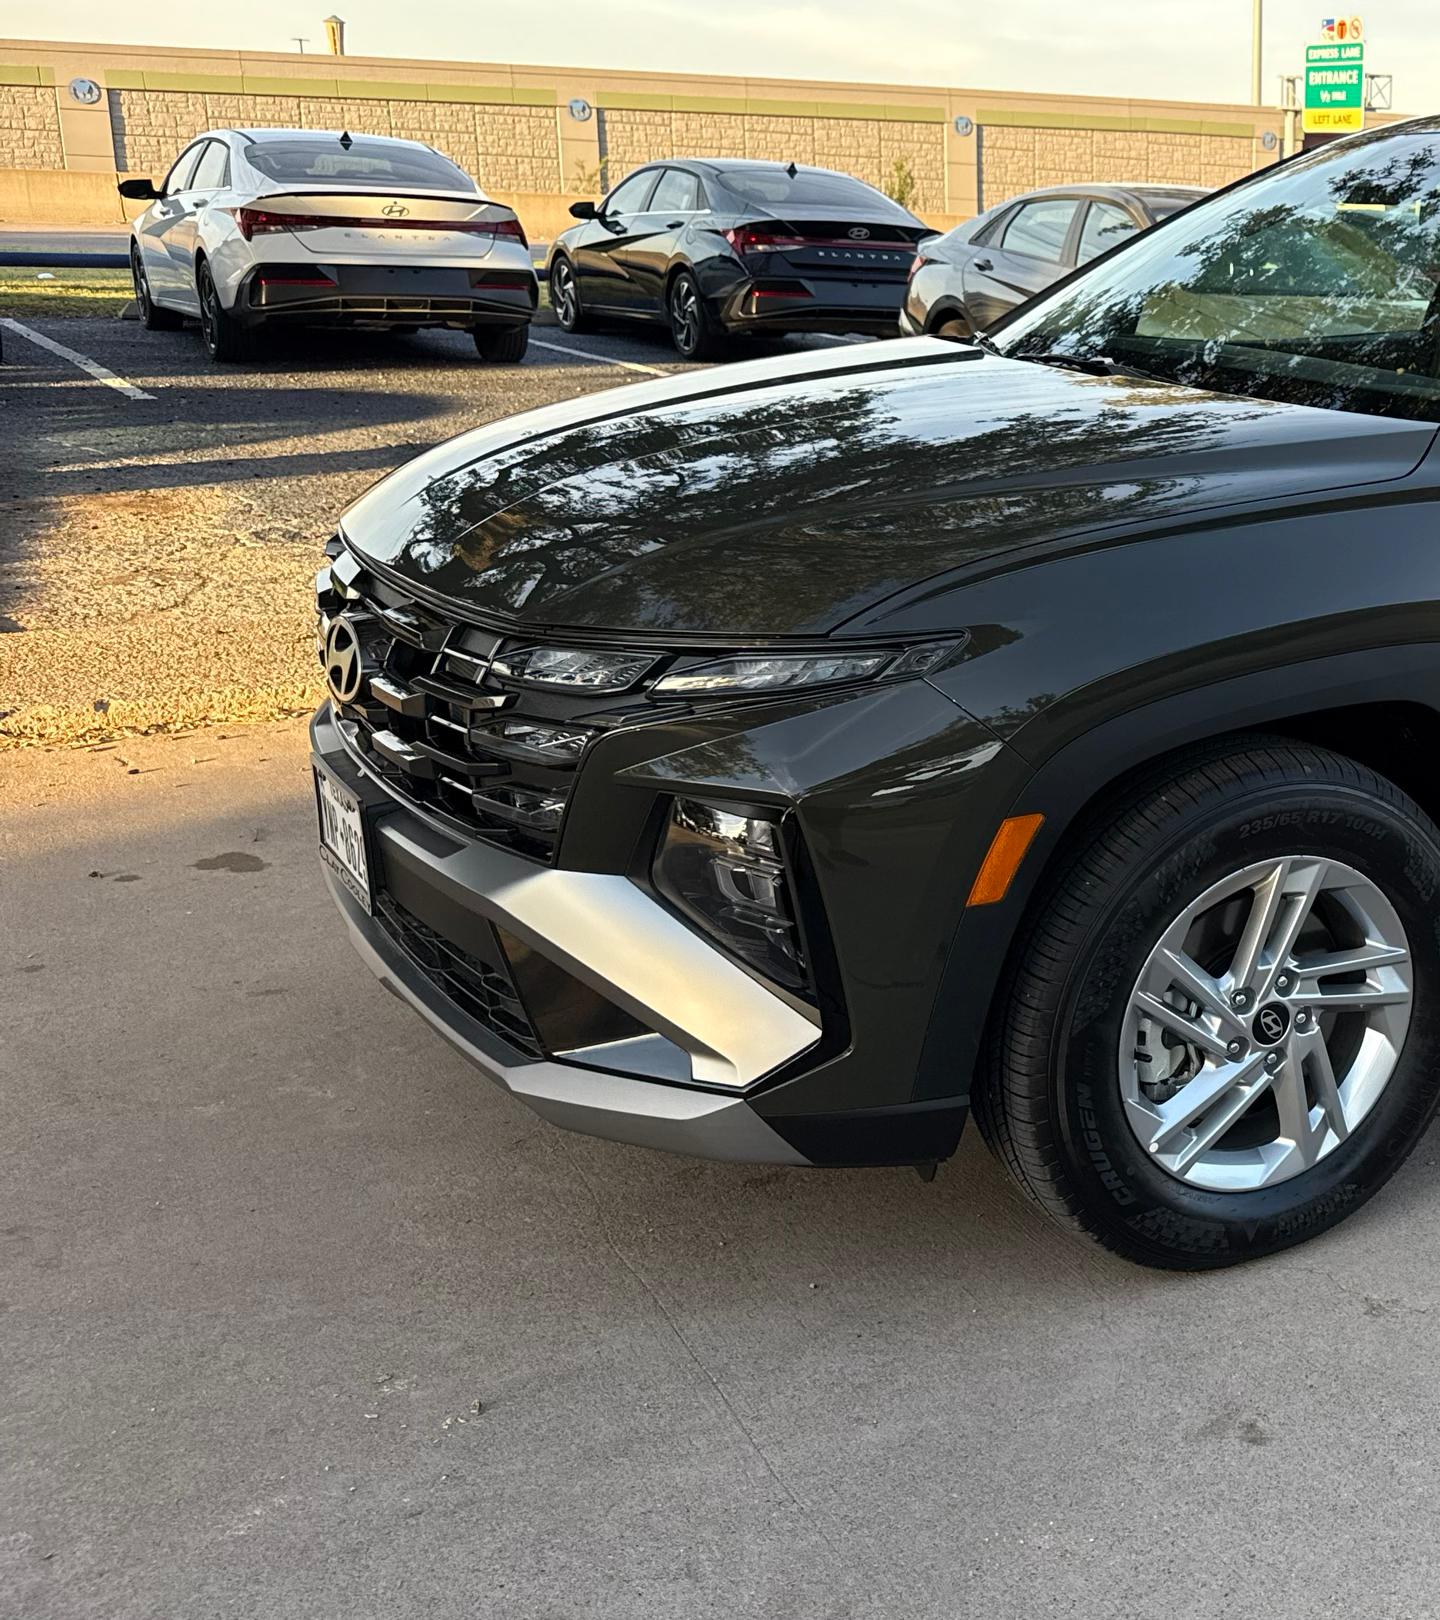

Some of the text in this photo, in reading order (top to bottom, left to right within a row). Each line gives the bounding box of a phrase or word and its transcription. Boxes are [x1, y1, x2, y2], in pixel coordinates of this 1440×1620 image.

[1341, 46, 1361, 58] LANE
[1309, 69, 1358, 86] ENTRANCE
[1313, 114, 1352, 124] LEFT LANE
[344, 232, 451, 241] ELANTRA
[818, 251, 901, 261] ELANTRA
[1239, 810, 1390, 841] 235/65 R17 104H
[1076, 1081, 1138, 1207] CRUGEN
